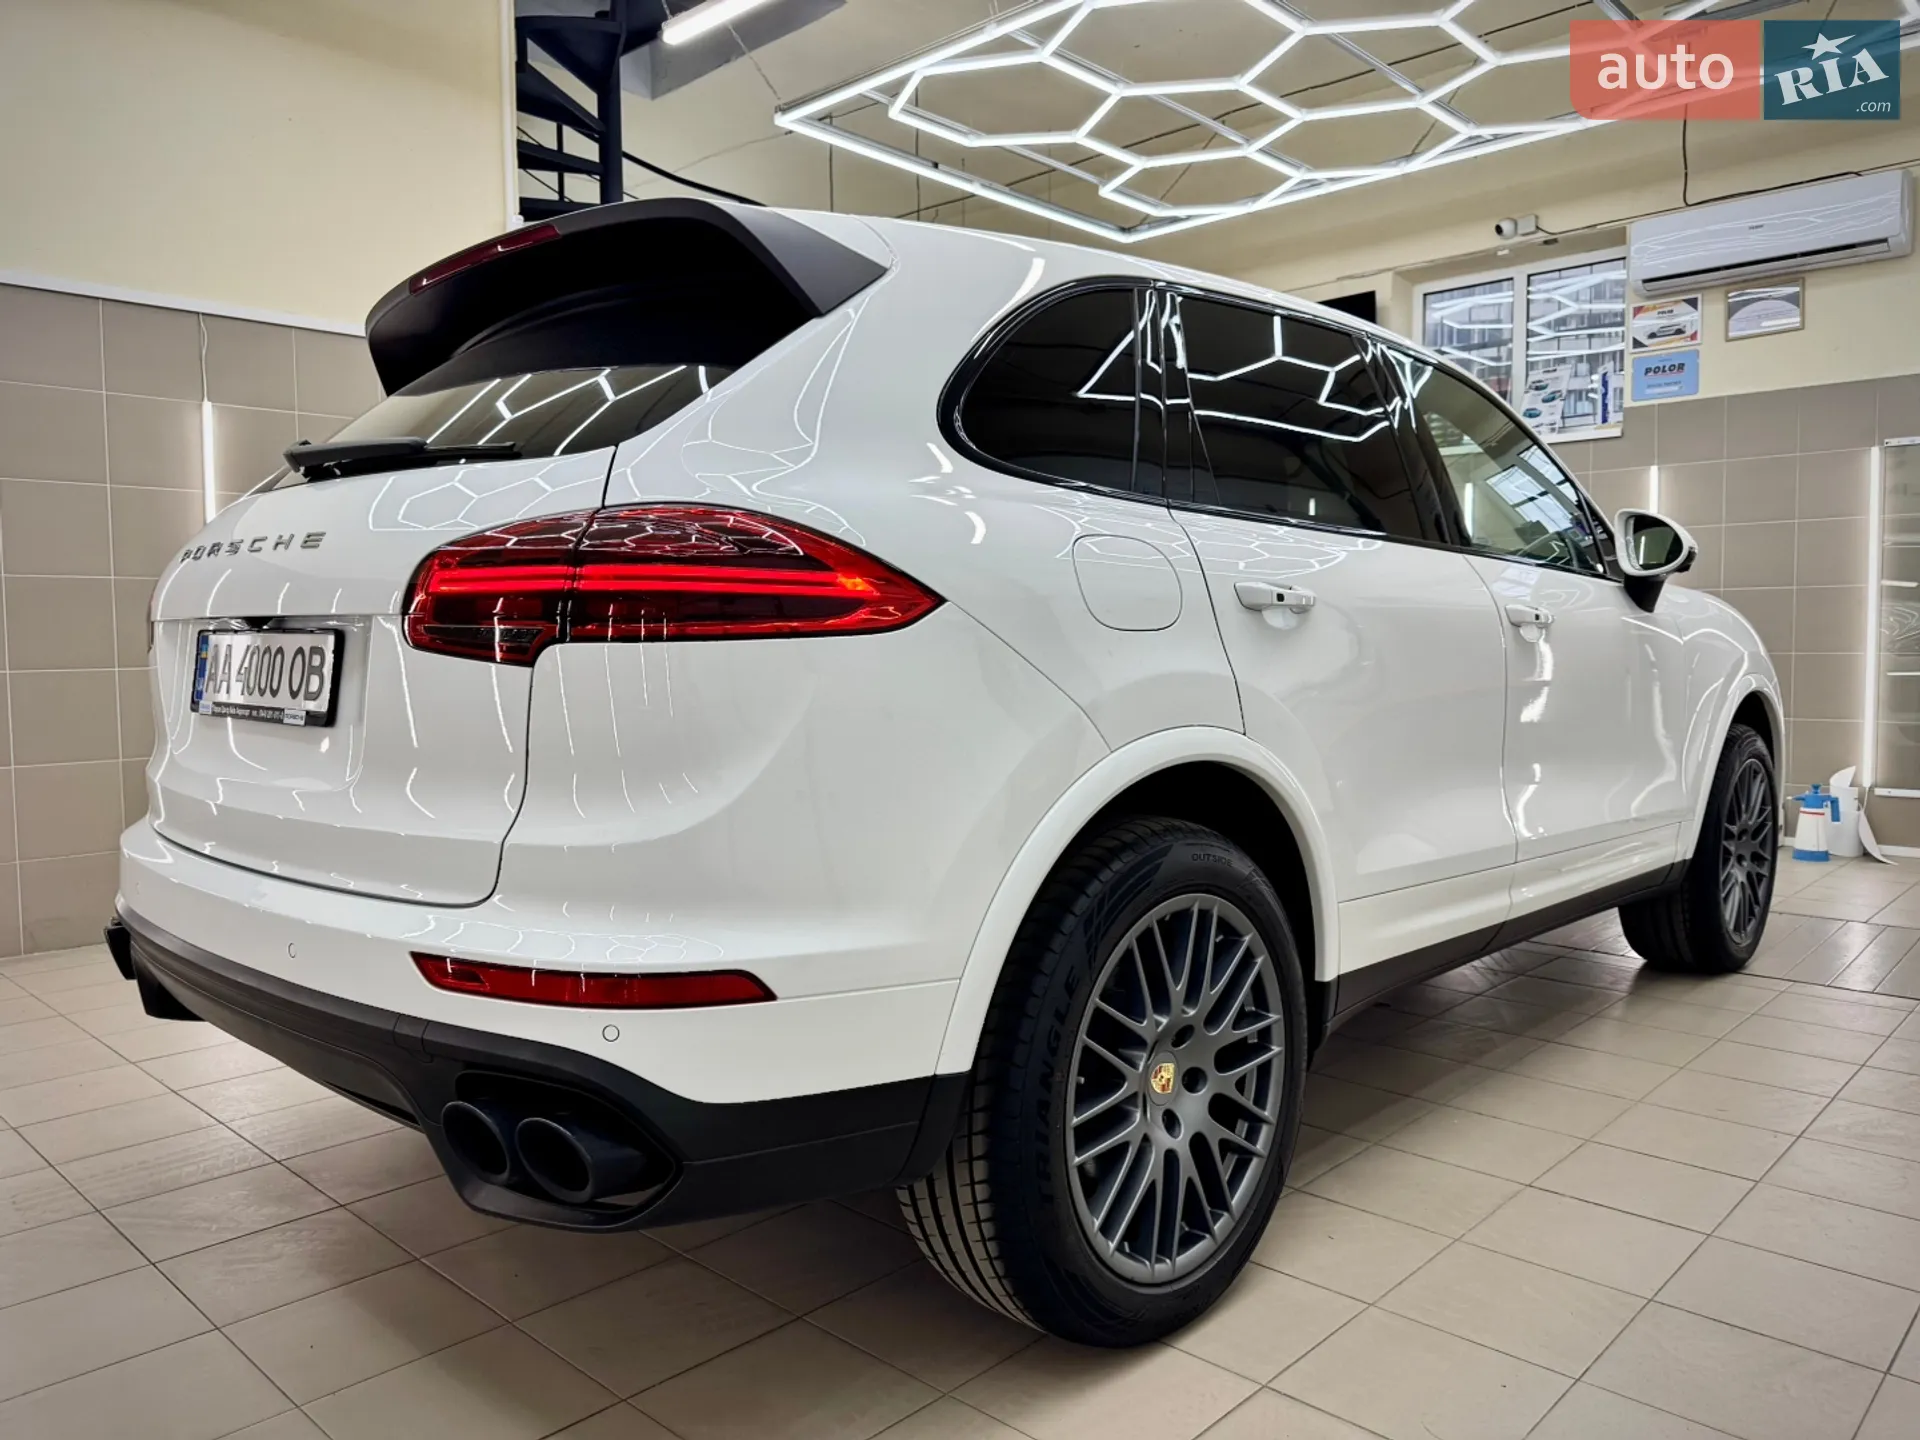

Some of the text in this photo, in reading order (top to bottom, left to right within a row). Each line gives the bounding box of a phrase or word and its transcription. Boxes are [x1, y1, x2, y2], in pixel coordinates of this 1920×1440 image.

[1643, 362, 1686, 377] POLOR
[179, 531, 327, 563] PORSCHE
[204, 643, 326, 702] AA 4000 OB
[1191, 853, 1234, 868] OUTSIDE
[1034, 964, 1080, 1206] TRIANGLE
